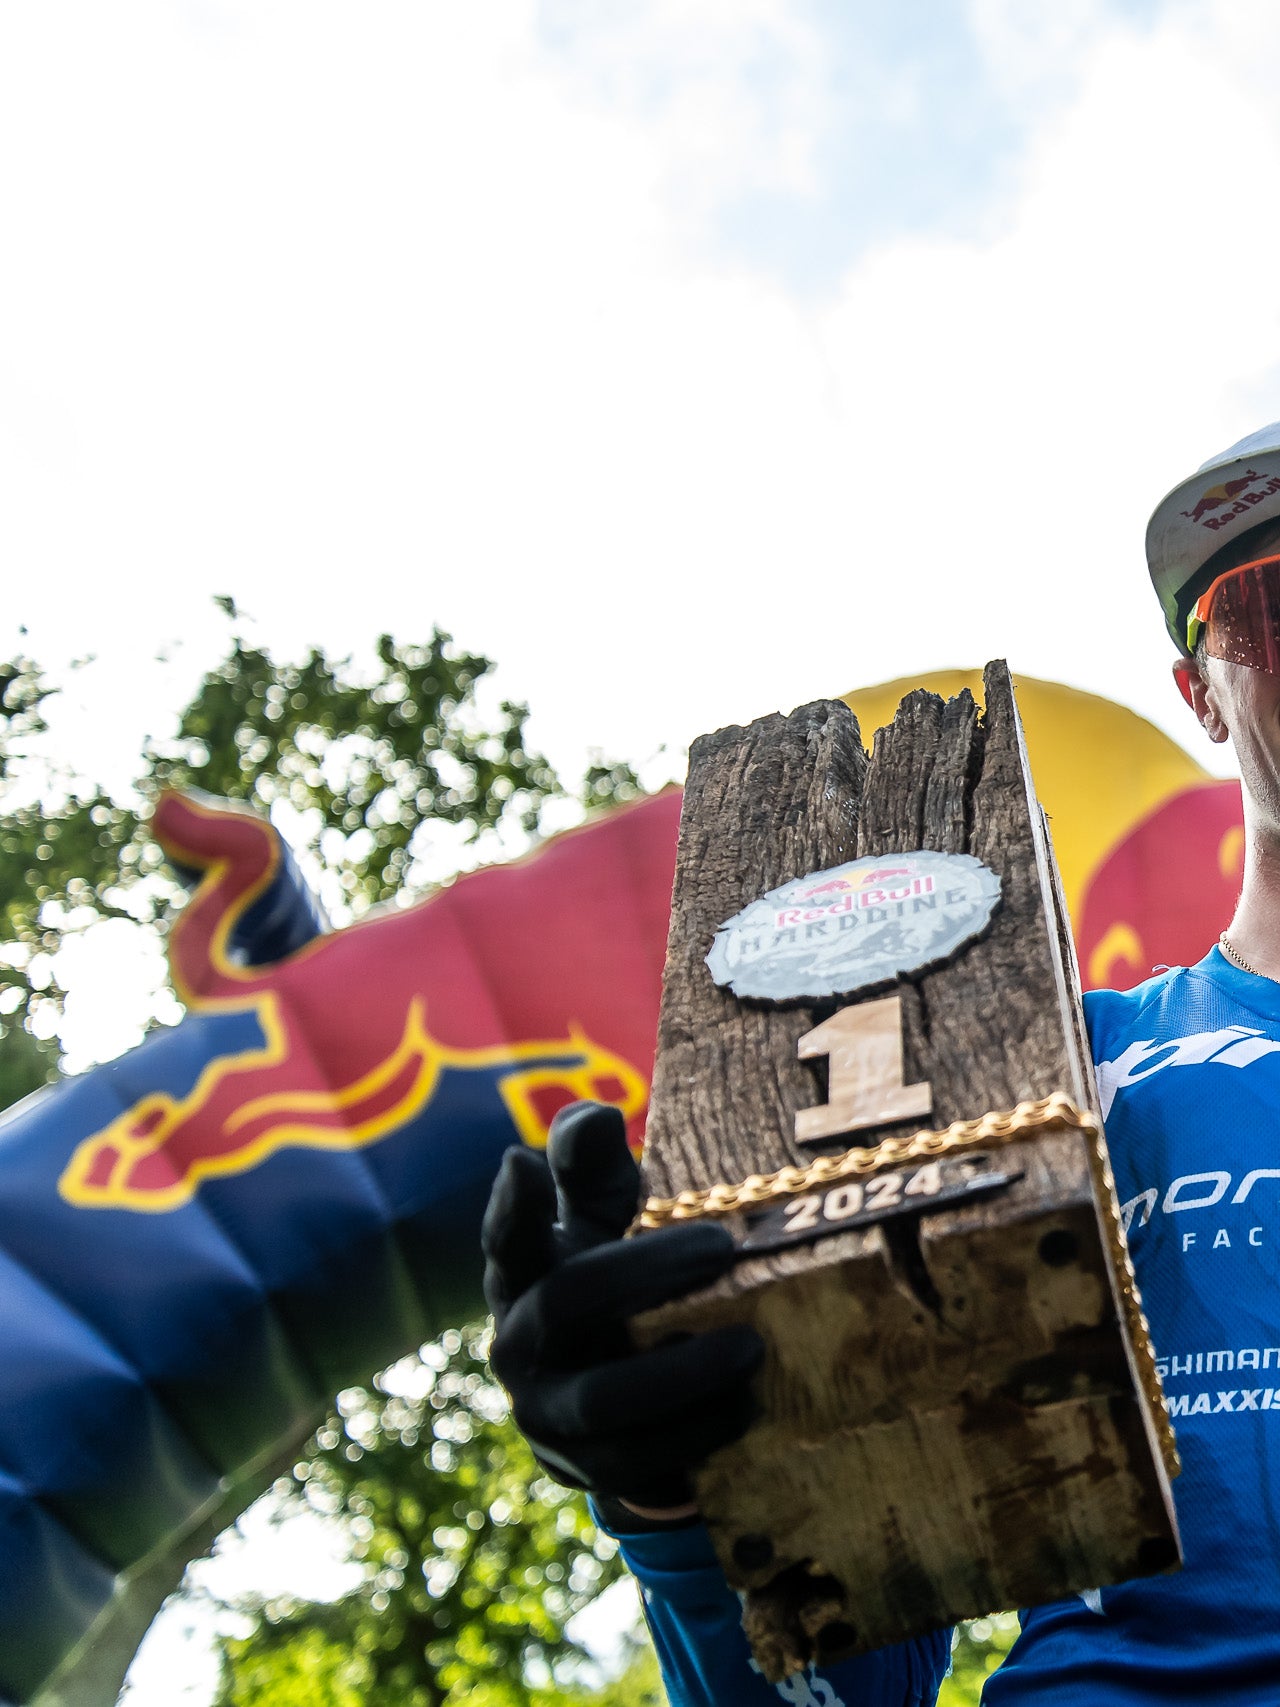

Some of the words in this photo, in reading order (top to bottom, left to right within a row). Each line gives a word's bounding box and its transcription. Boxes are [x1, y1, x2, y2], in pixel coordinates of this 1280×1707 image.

[1203, 501, 1250, 530] Red
[776, 896, 853, 928] Red
[860, 876, 934, 910] Bull
[794, 996, 932, 1143] 1
[783, 1162, 943, 1233] 2024
